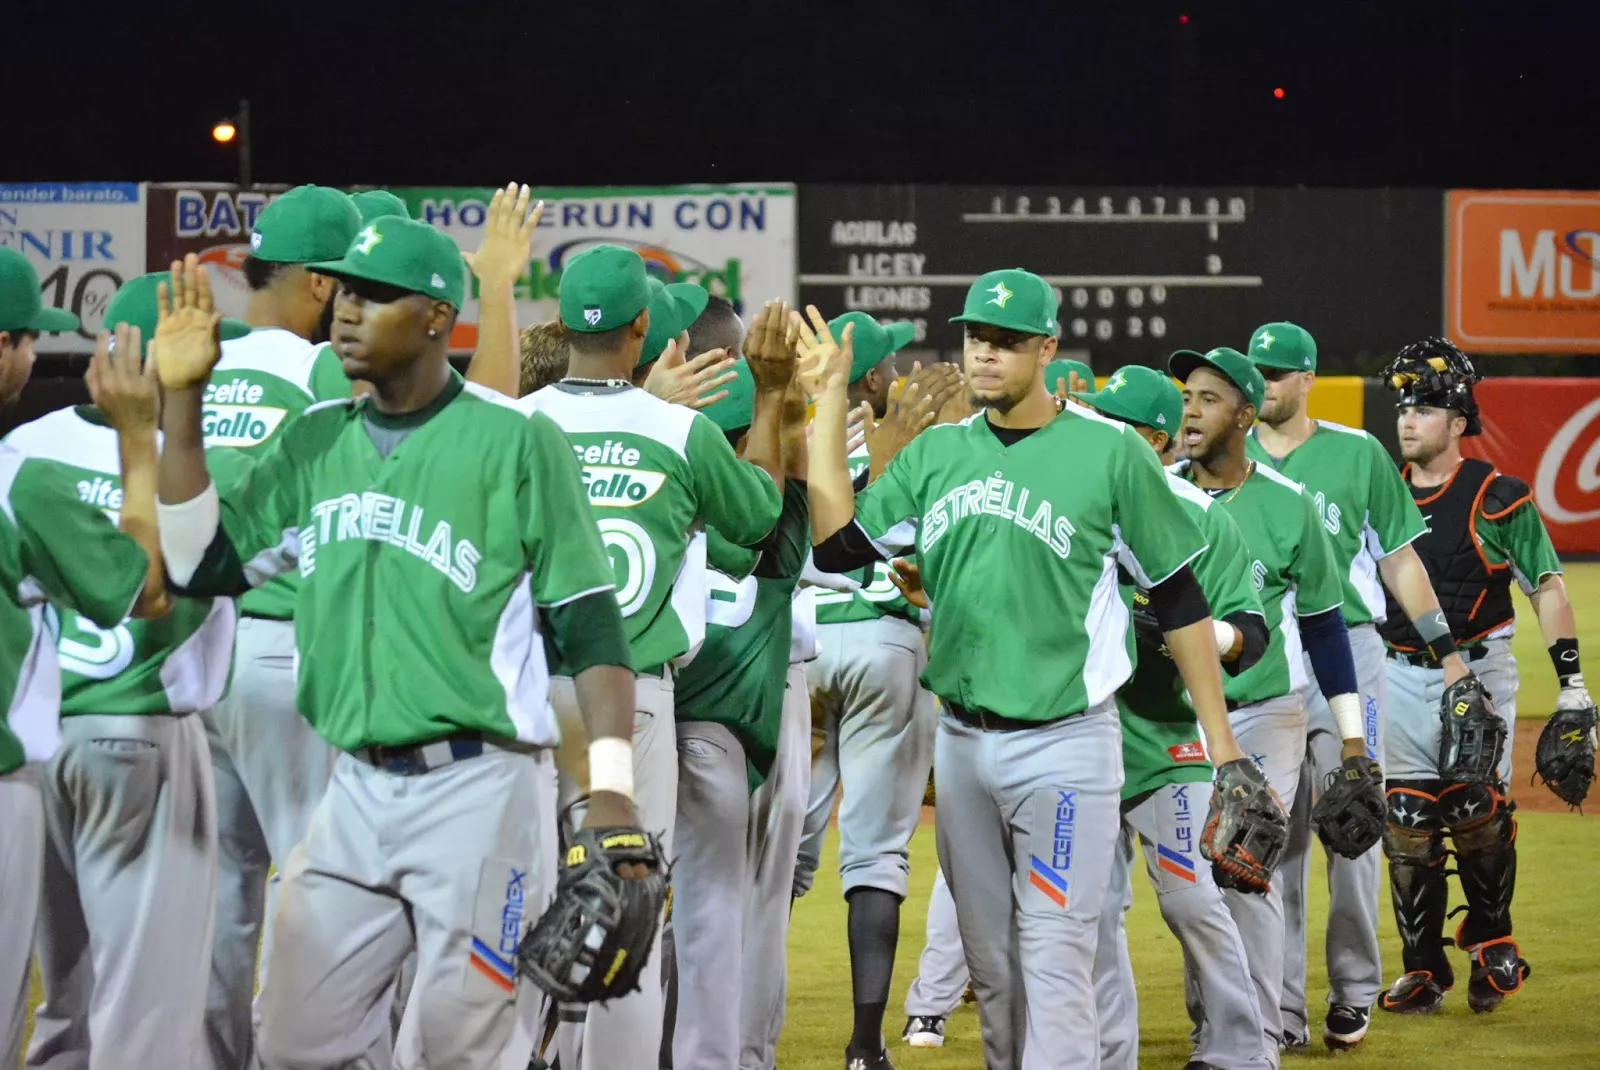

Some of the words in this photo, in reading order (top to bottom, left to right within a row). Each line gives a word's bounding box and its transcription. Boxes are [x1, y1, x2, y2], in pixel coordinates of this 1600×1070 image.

[0, 187, 57, 201] ender
[62, 186, 129, 201] barato.
[176, 191, 272, 236] BAT
[424, 203, 655, 228] HOERUN
[674, 199, 768, 230] CON
[832, 221, 918, 247] AGUILAS
[848, 253, 926, 276] LICEY
[845, 286, 931, 311] LEONES
[203, 378, 264, 404] ceite
[573, 440, 641, 466] ceite
[77, 477, 122, 510] eite
[922, 476, 1077, 559] ESTRELLAS
[298, 491, 482, 593] ETRELLAS
[1052, 790, 1077, 871] CEMEX
[499, 867, 527, 955] CEMEX
